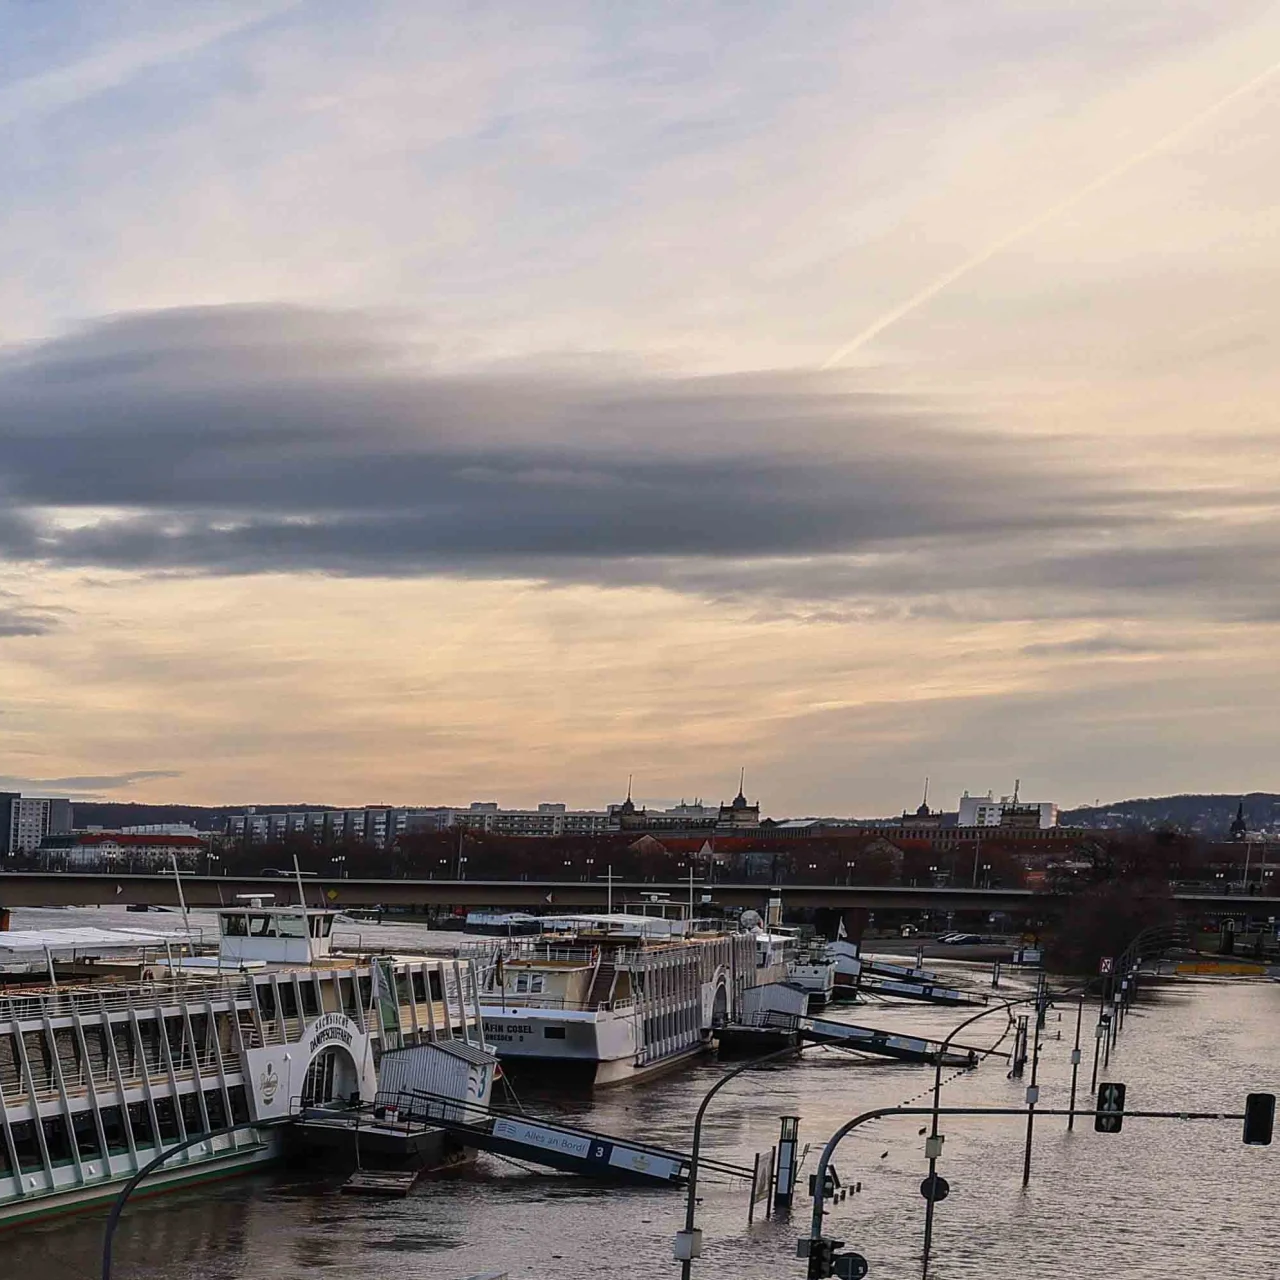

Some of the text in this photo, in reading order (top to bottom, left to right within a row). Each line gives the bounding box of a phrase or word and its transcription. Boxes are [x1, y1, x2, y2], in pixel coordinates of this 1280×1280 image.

[507, 1025, 534, 1034] COSEL
[477, 1065, 487, 1099] 3
[524, 1130, 587, 1154] Alles an Bord!
[595, 1147, 604, 1158] 3
